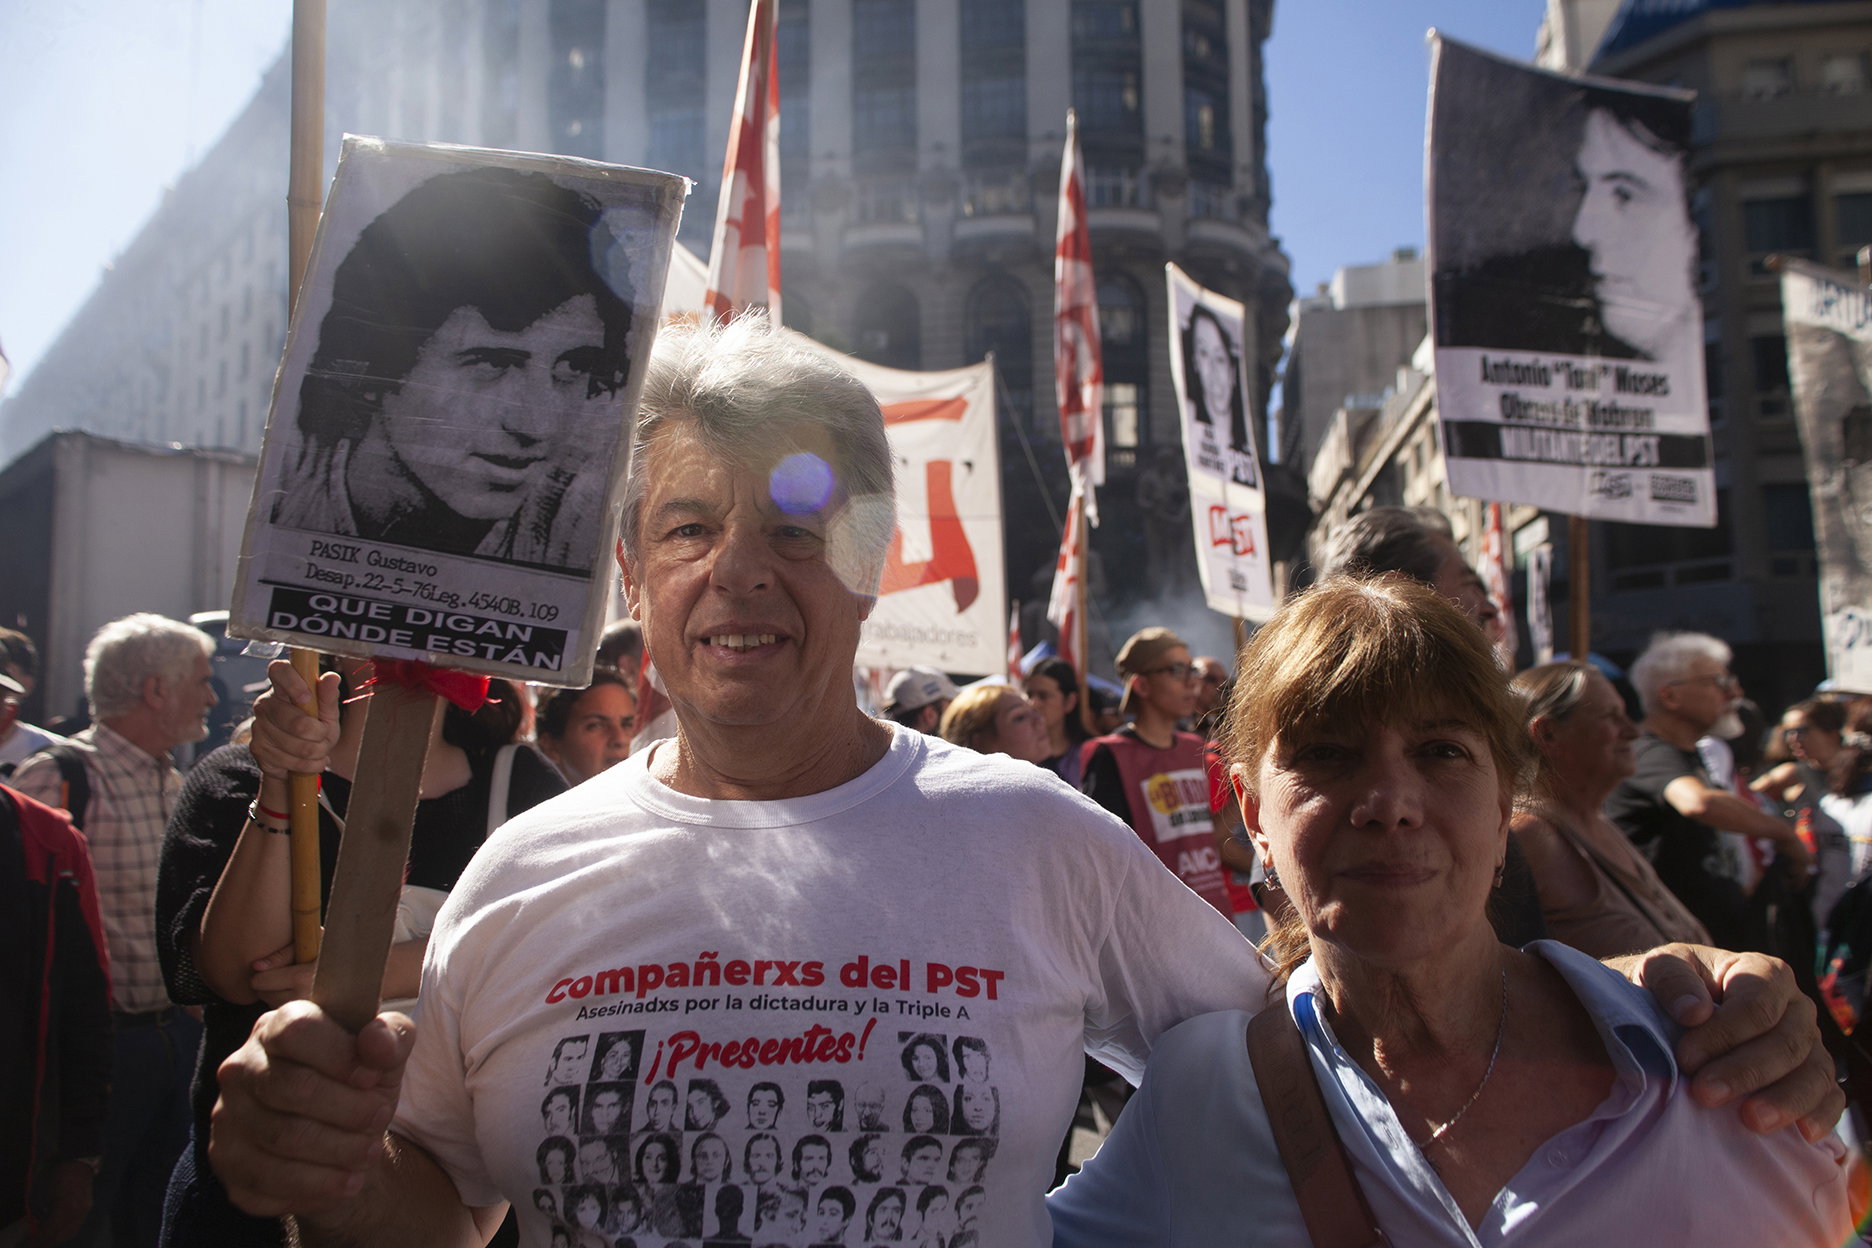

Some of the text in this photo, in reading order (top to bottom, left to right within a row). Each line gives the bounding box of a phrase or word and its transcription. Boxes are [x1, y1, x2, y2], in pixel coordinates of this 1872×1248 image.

[1480, 354, 1551, 388] Antonio
[1623, 434, 1661, 466] PST
[309, 540, 438, 577] PASIK Gustavo
[307, 594, 533, 642] QUE DIGAN
[271, 611, 561, 671] DÓNDE ESTÁN
[839, 954, 911, 993] del
[926, 961, 1005, 1001] PST
[575, 994, 971, 1021] Asesinadxs por la dictadura y la Triple A
[644, 1018, 878, 1086] ¡Presentes!
